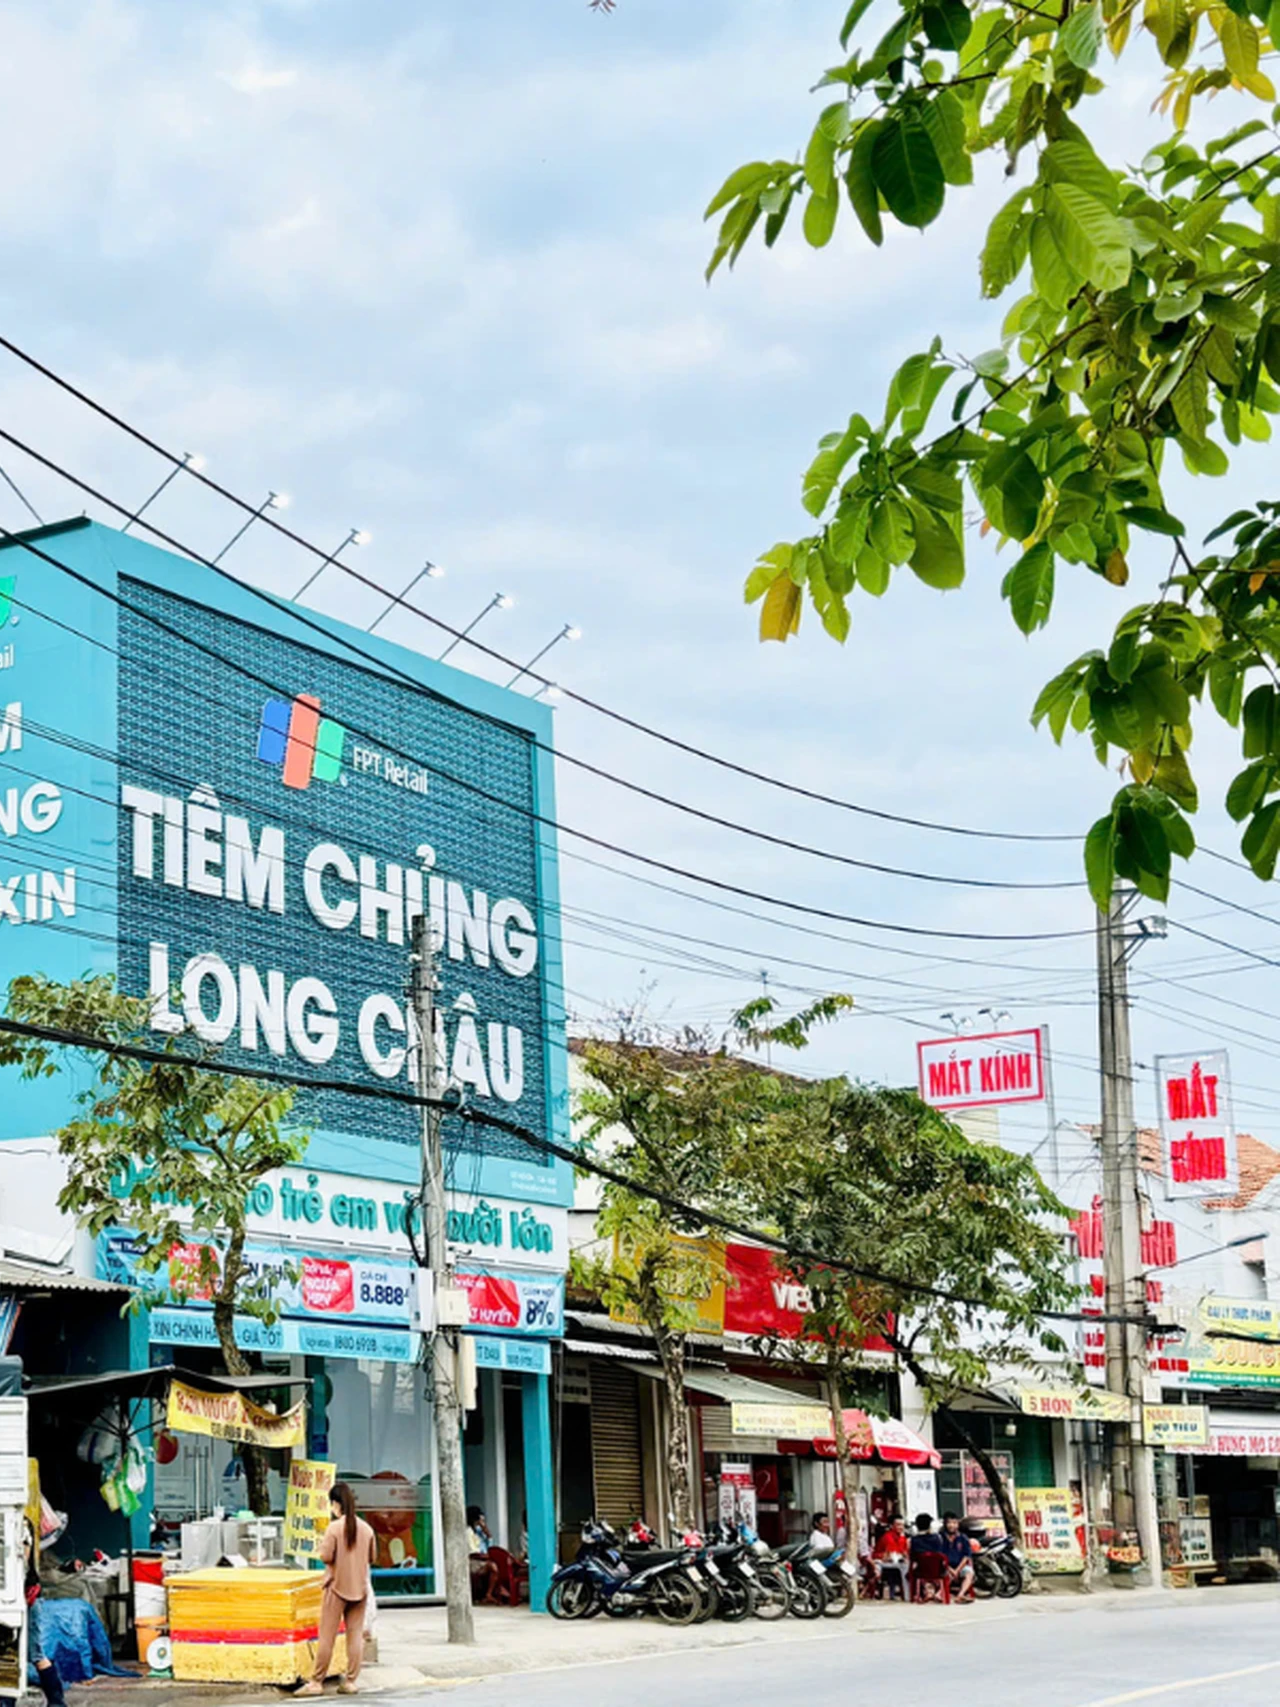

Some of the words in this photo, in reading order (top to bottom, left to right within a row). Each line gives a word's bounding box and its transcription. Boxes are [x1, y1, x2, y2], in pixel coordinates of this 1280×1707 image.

[352, 745, 382, 780] FPT
[383, 758, 430, 796] Retail
[121, 782, 286, 916] TIÊM
[303, 844, 540, 979] CHỦNG
[148, 941, 341, 1065] LONG
[928, 1050, 973, 1098] MẮT
[980, 1049, 1032, 1094] KÍNH
[1167, 1061, 1219, 1121] MẮT
[1170, 1131, 1228, 1183] KÍNH
[280, 1172, 324, 1223] trẻ
[329, 1192, 378, 1232] em
[509, 1206, 554, 1254] lớn
